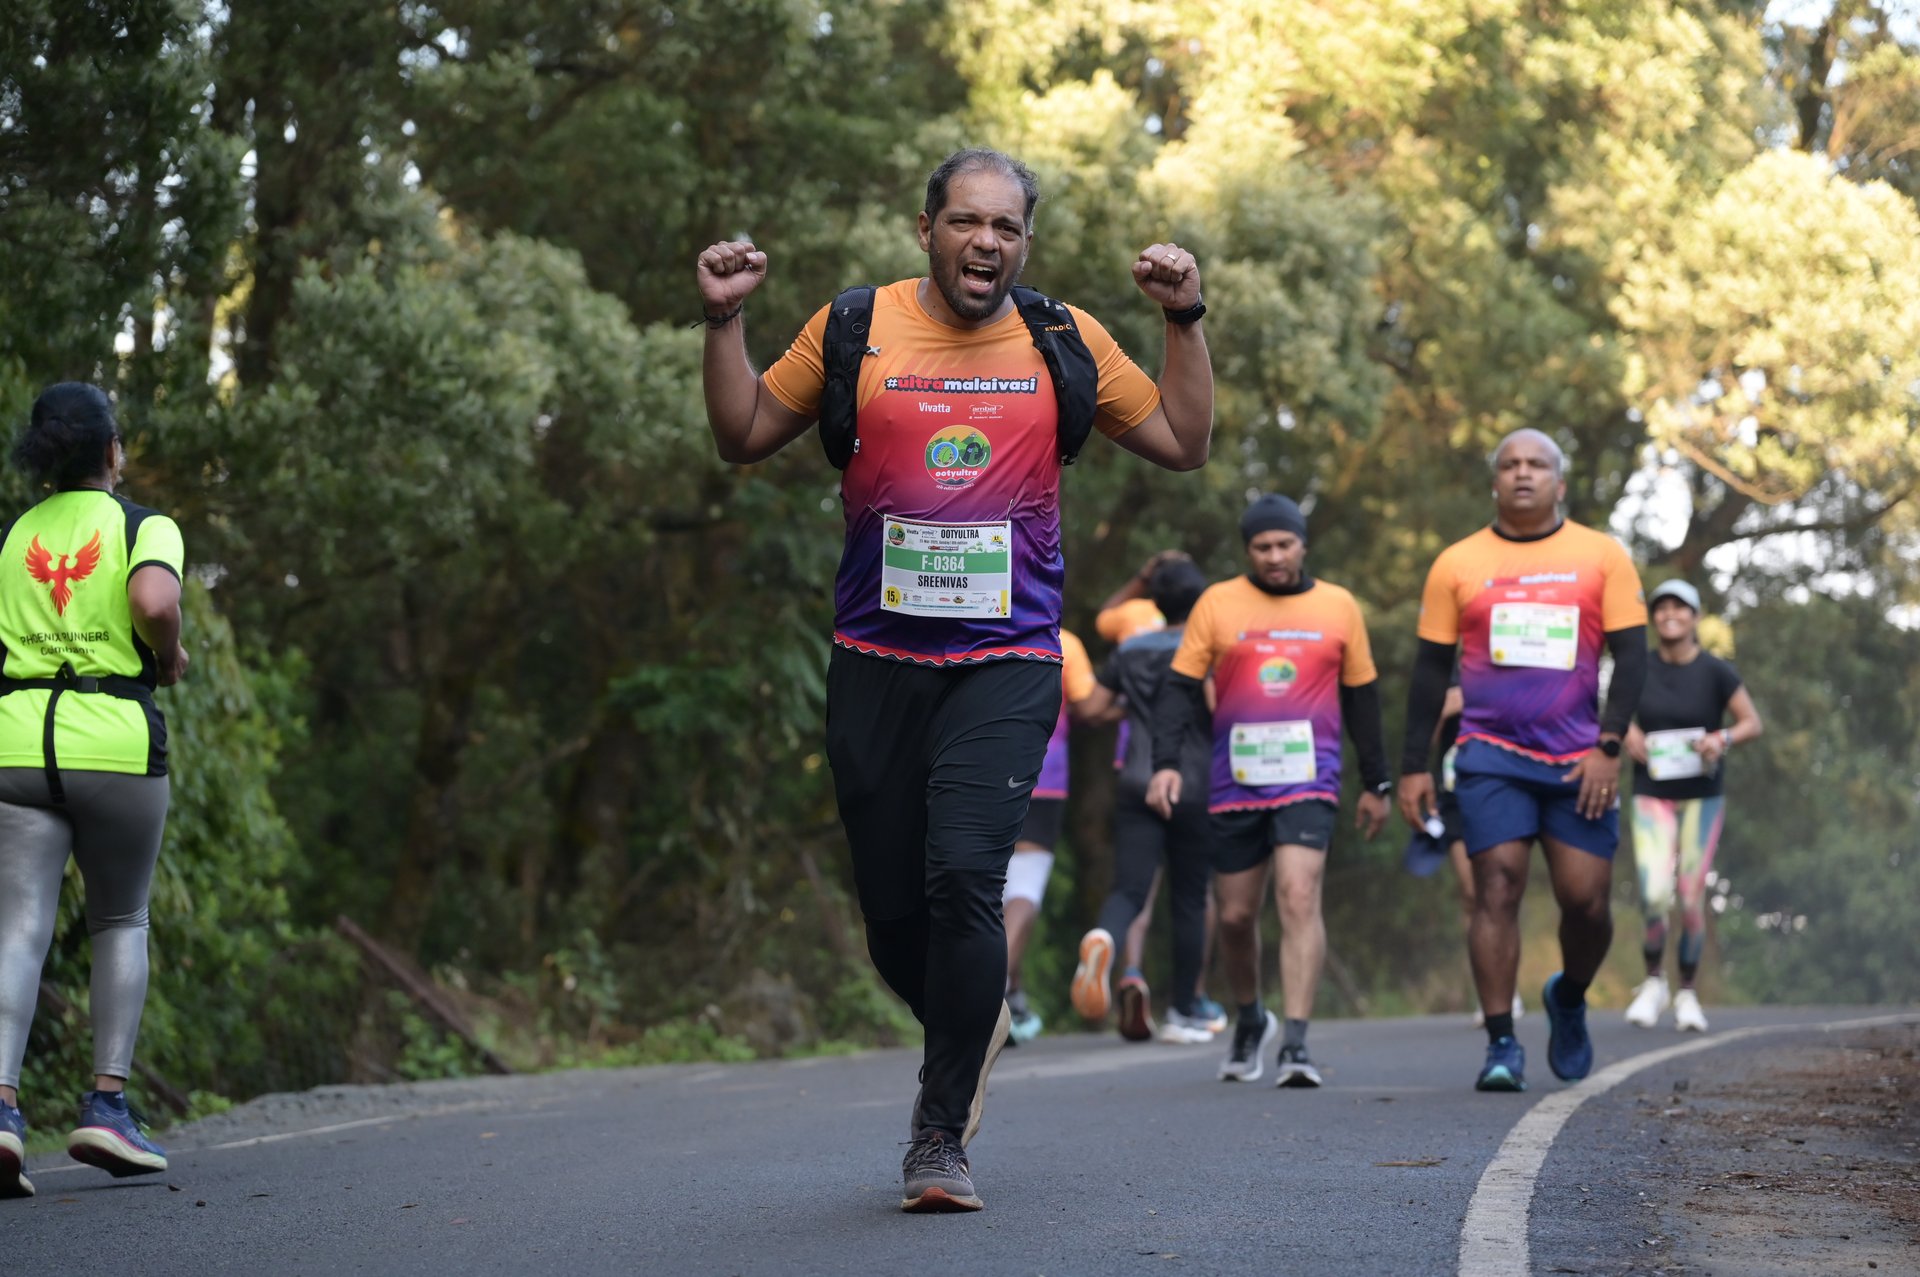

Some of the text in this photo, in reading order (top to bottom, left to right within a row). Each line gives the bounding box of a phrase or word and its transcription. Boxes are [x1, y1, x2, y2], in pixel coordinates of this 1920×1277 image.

[885, 375, 1038, 394] #ultramalaivasi
[918, 402, 951, 413] Vivatta
[935, 469, 978, 477] ootyultra
[941, 529, 979, 539] OOTYULTRA
[922, 555, 966, 572] F-0364
[918, 575, 968, 588] SREENIVAS
[886, 590, 895, 602] 15
[20, 630, 110, 646] PHOENIX RUNNERS
